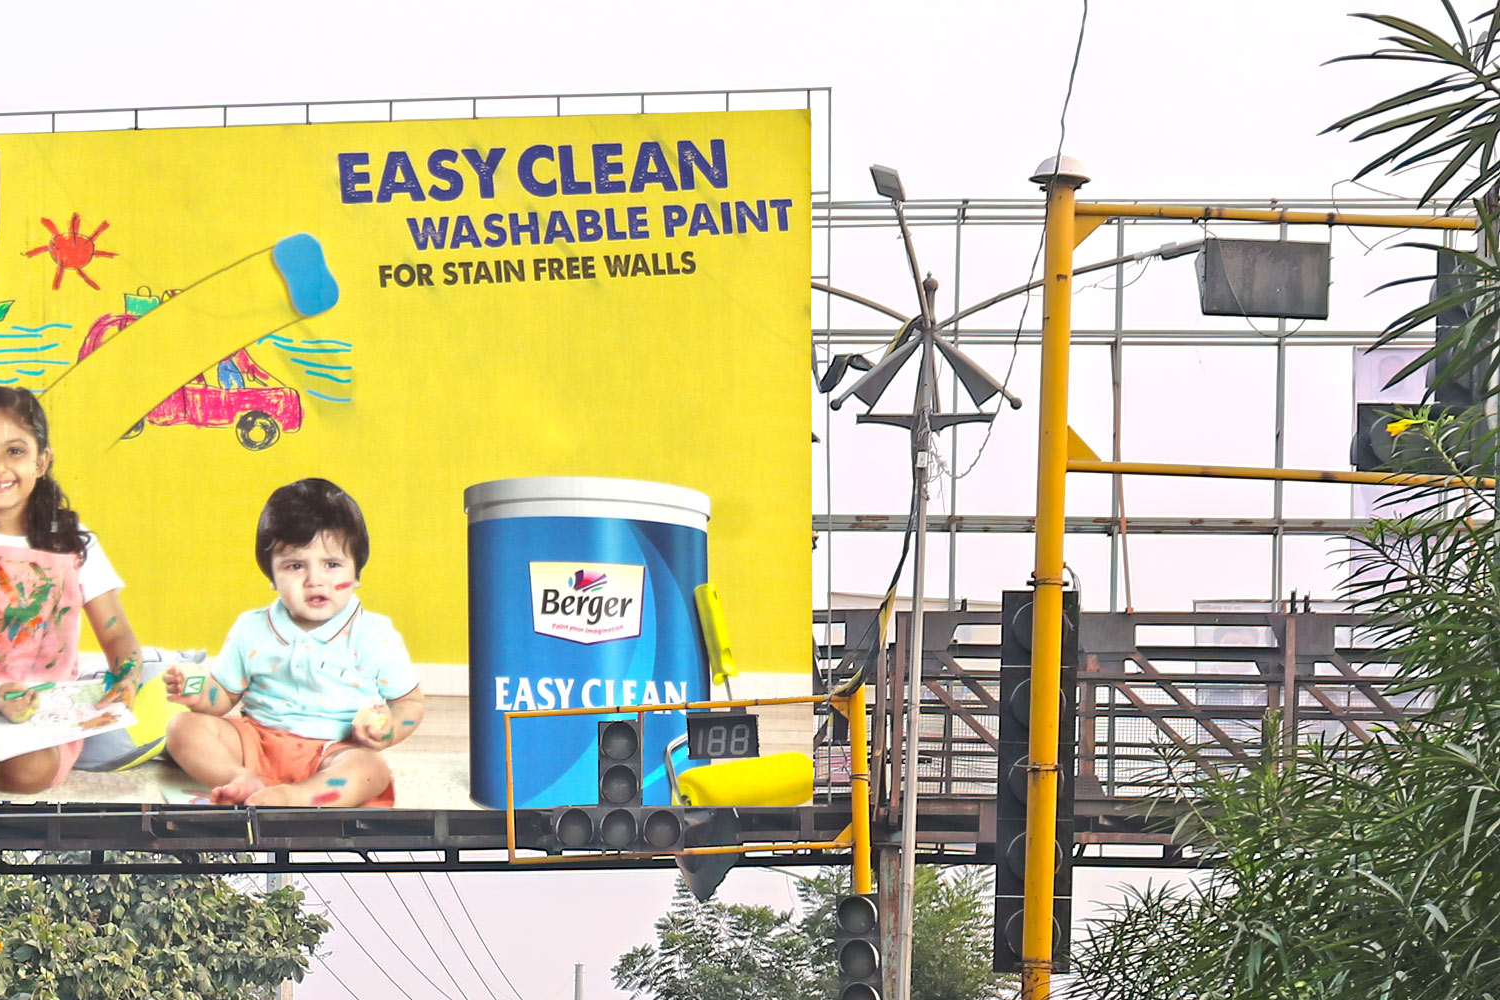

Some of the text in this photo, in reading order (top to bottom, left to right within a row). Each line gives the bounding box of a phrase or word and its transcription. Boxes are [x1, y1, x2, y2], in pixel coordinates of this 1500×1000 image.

[337, 139, 729, 204] EASY CLEAN
[407, 198, 793, 251] WASHABLE PAINT
[378, 251, 697, 288] FOR STAIN FREE WALLS
[540, 588, 633, 626] Berger
[551, 623, 624, 636] Paint your imagination
[495, 676, 576, 711] EASY
